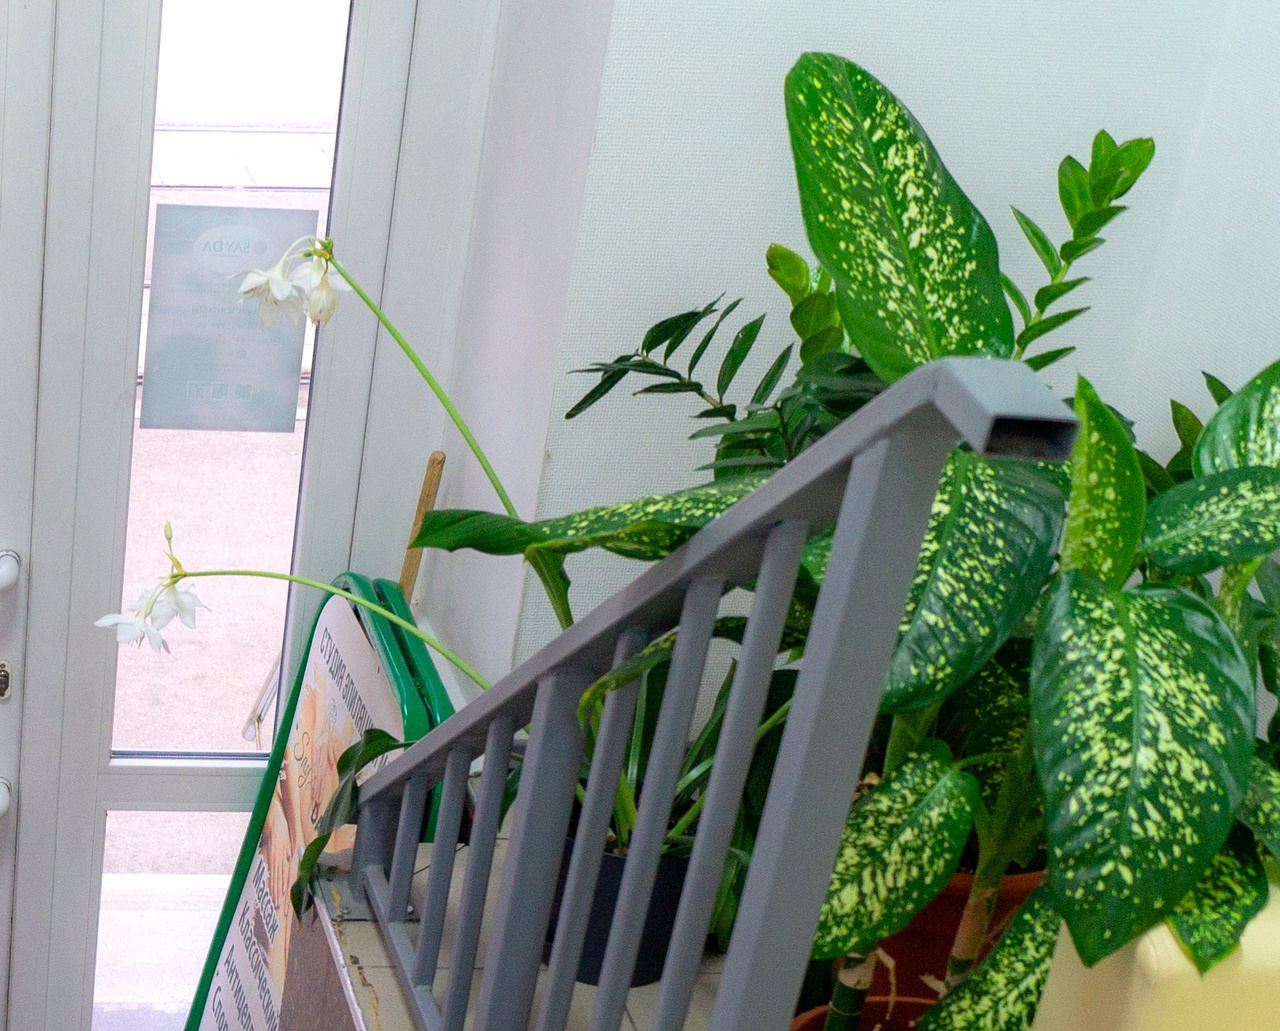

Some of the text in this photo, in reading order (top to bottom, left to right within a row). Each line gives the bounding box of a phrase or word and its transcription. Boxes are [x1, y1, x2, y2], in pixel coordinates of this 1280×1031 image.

[320, 627, 374, 739] СТУДИЯ ЭПИЛЯЦ
[252, 859, 279, 944] Массаж
